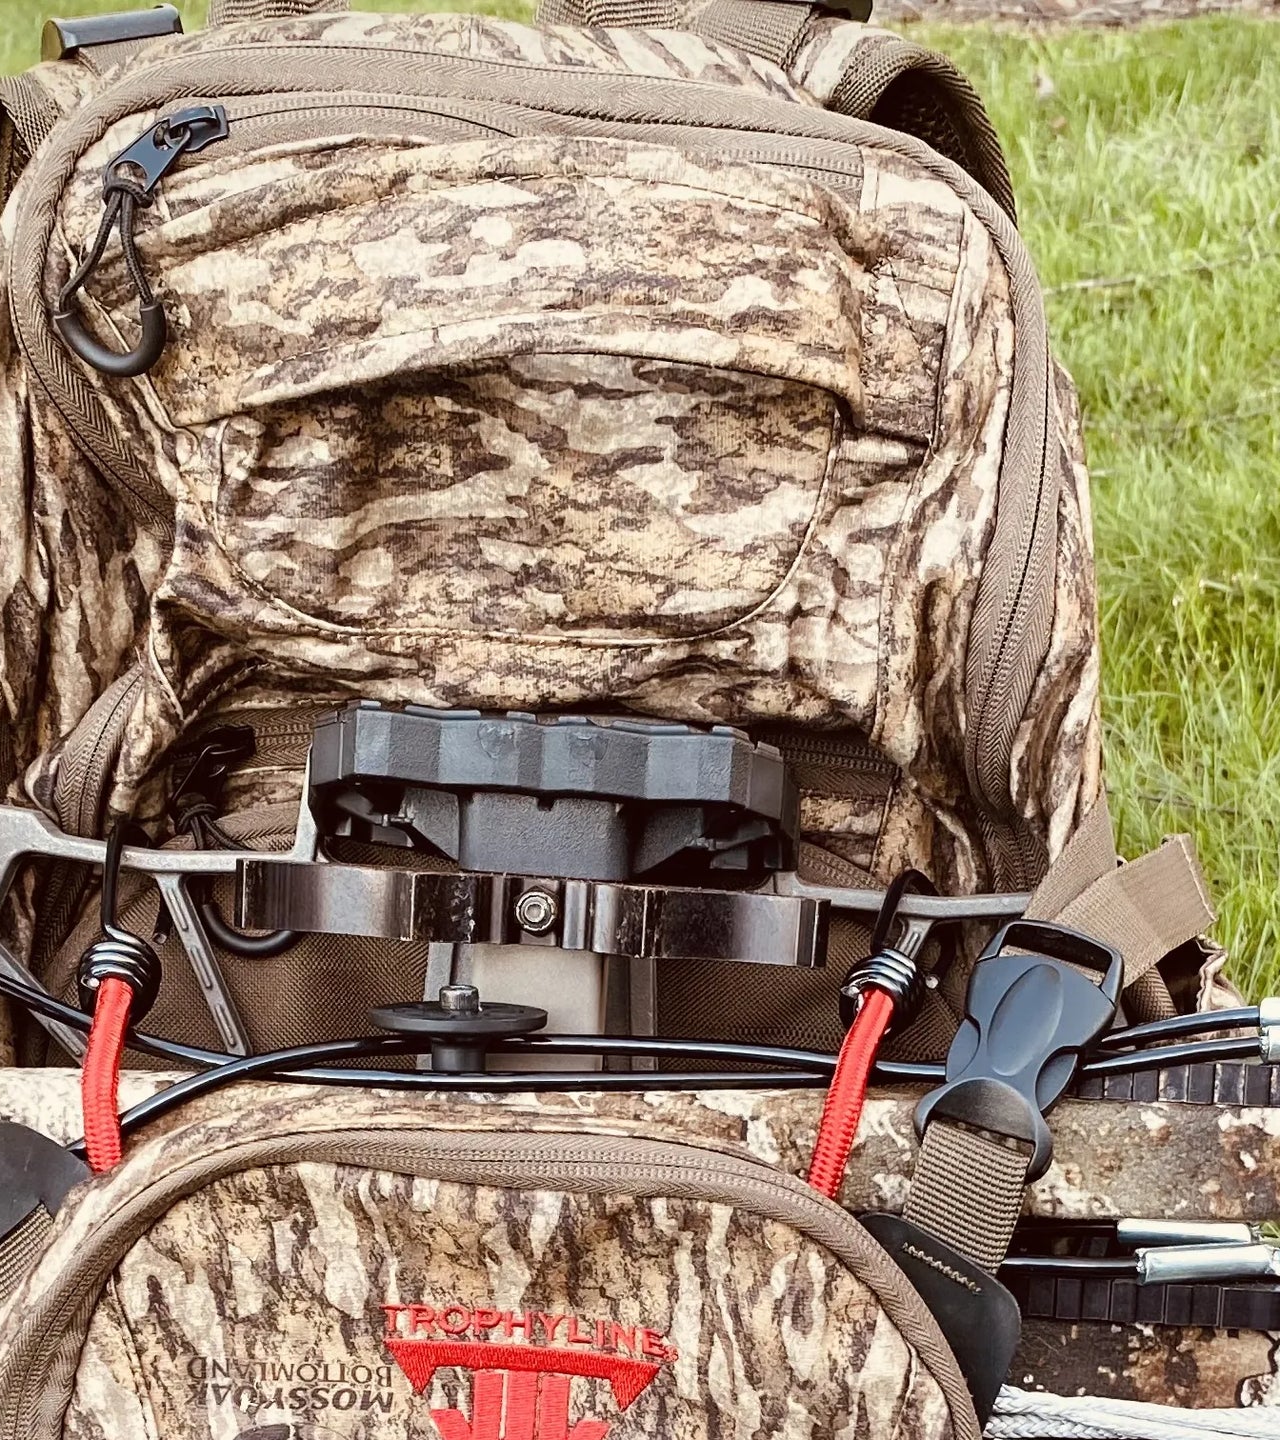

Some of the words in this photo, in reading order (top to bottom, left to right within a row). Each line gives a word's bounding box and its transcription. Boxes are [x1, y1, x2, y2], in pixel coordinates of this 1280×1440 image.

[379, 1302, 666, 1358] TROPHYLINE
[187, 1357, 393, 1388] BOTTOMLAND
[185, 1383, 254, 1411] OAK
[262, 1387, 394, 1414] MOSSY
